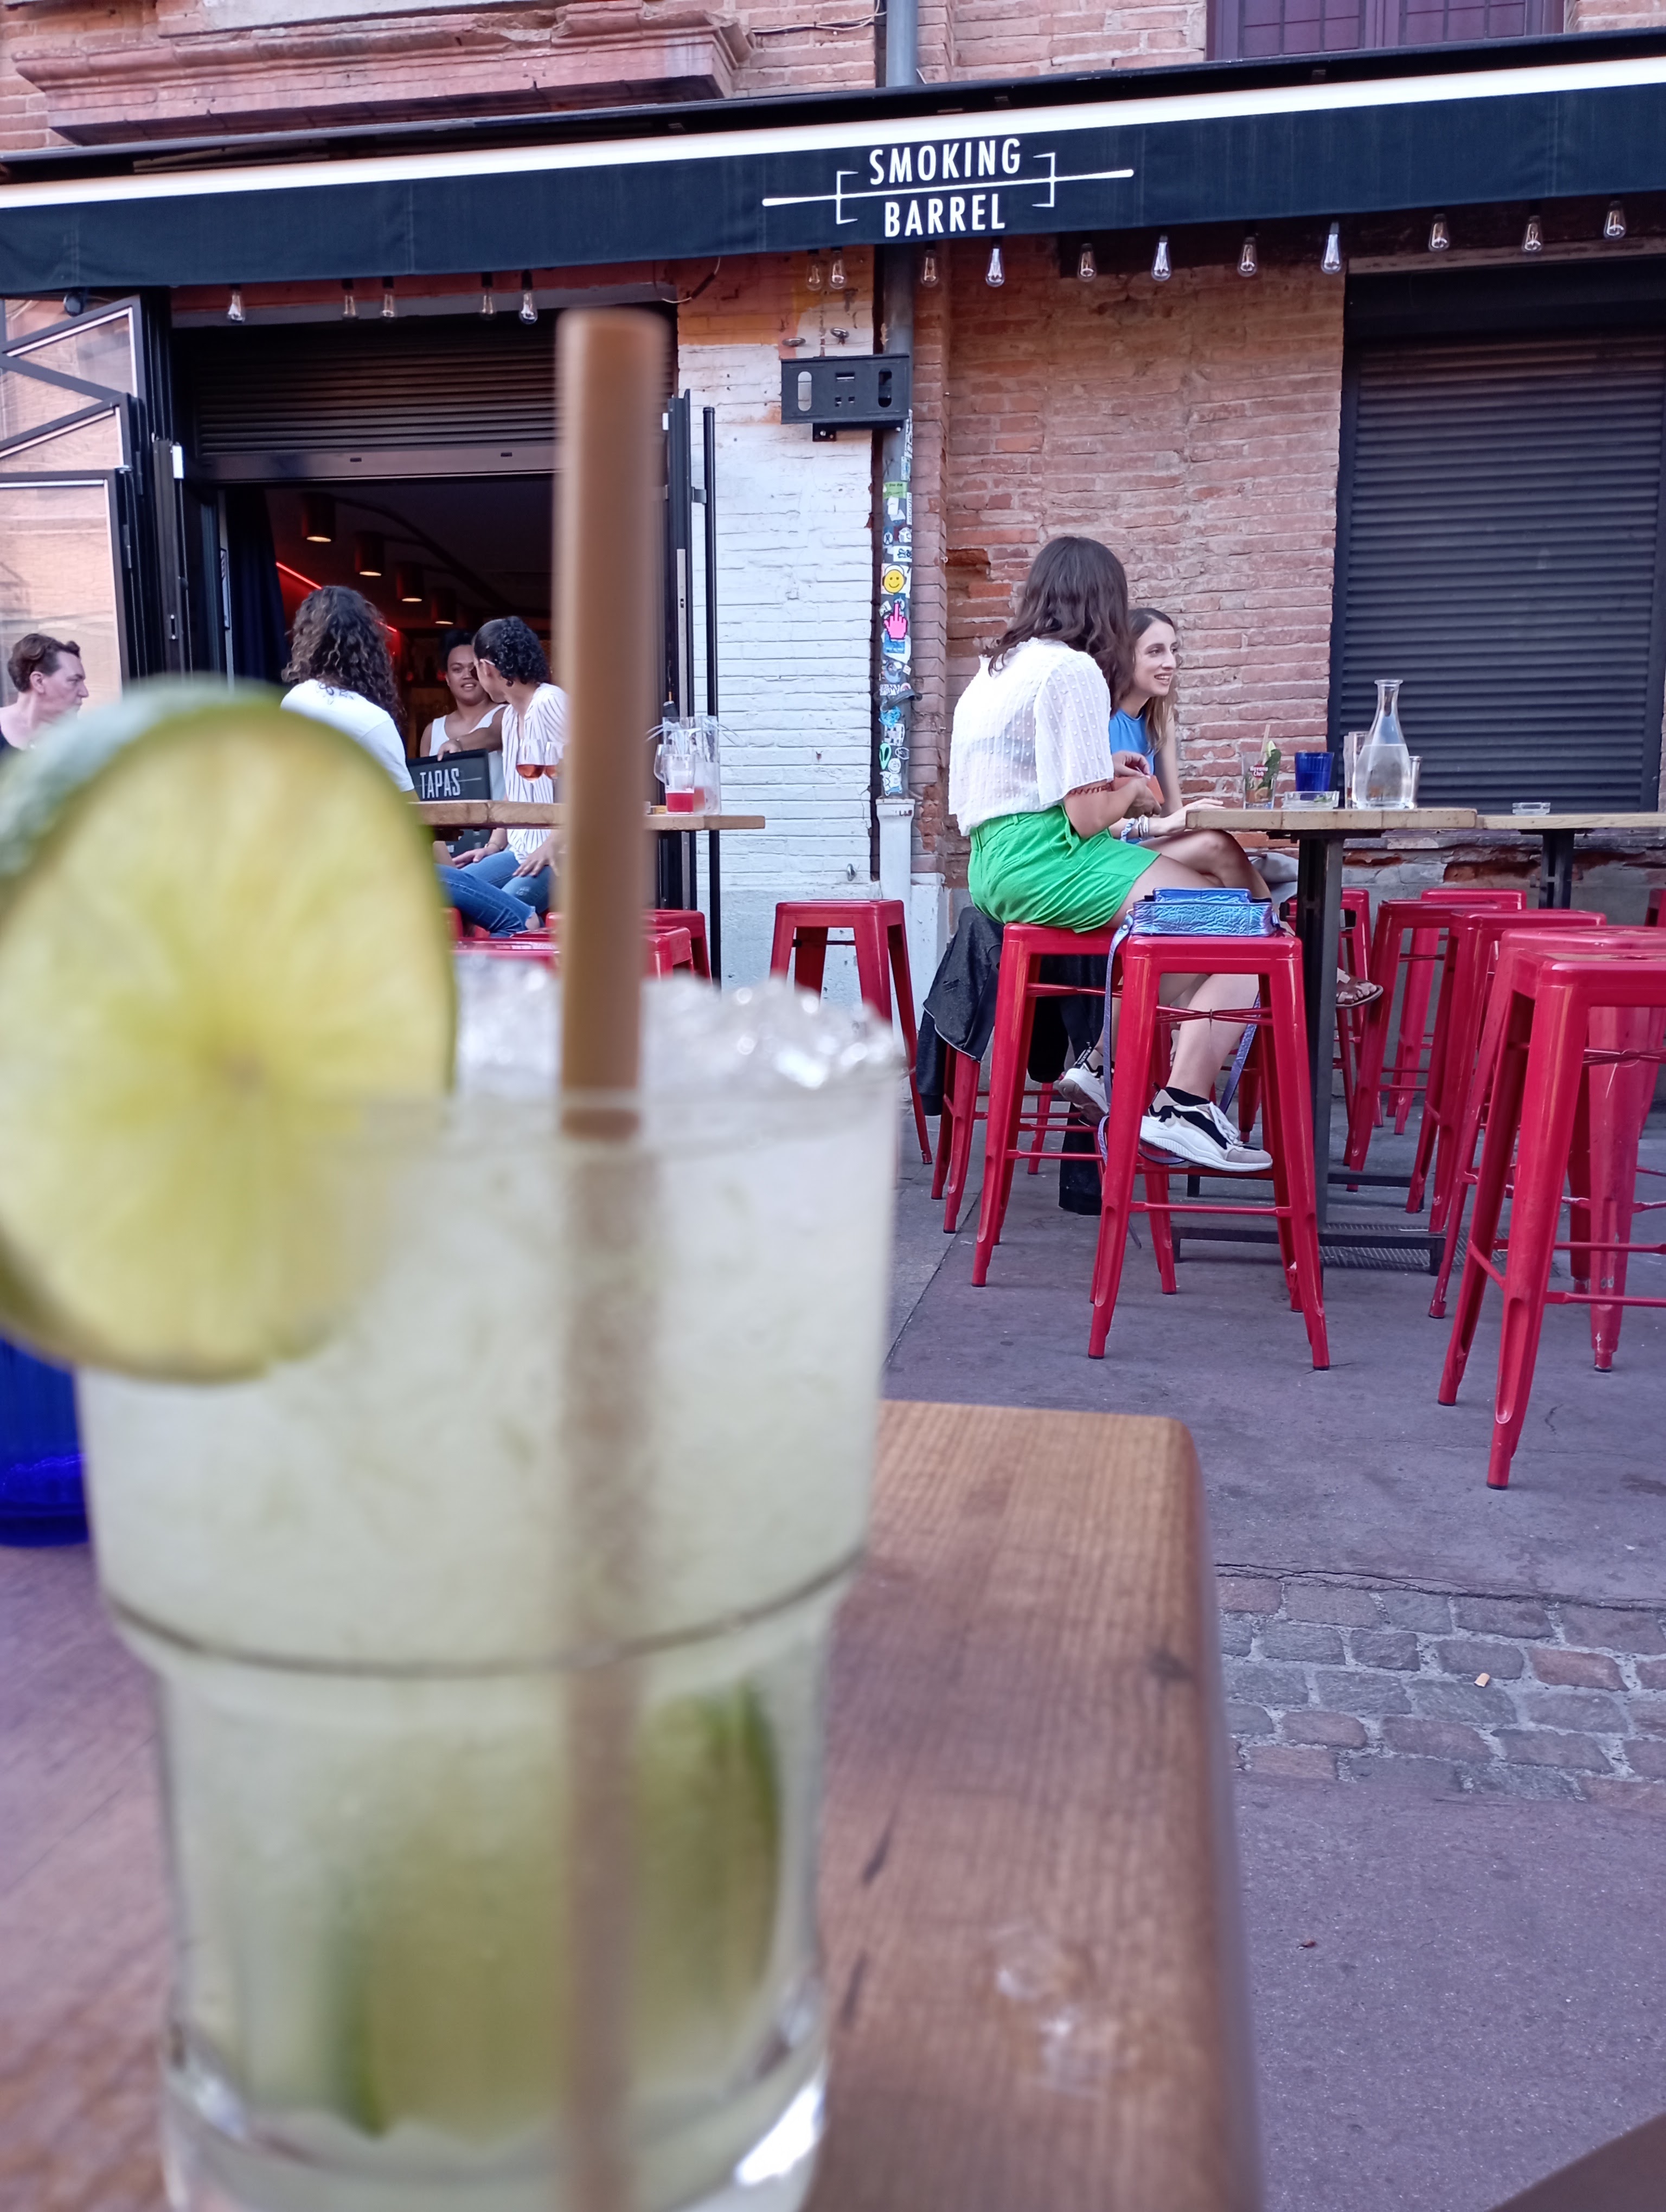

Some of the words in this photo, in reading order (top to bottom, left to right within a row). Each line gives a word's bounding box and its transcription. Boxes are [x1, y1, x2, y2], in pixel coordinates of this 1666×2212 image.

[869, 138, 1021, 185] SMOKING
[884, 193, 1006, 238] BARREL
[419, 768, 461, 799] TAPAS
